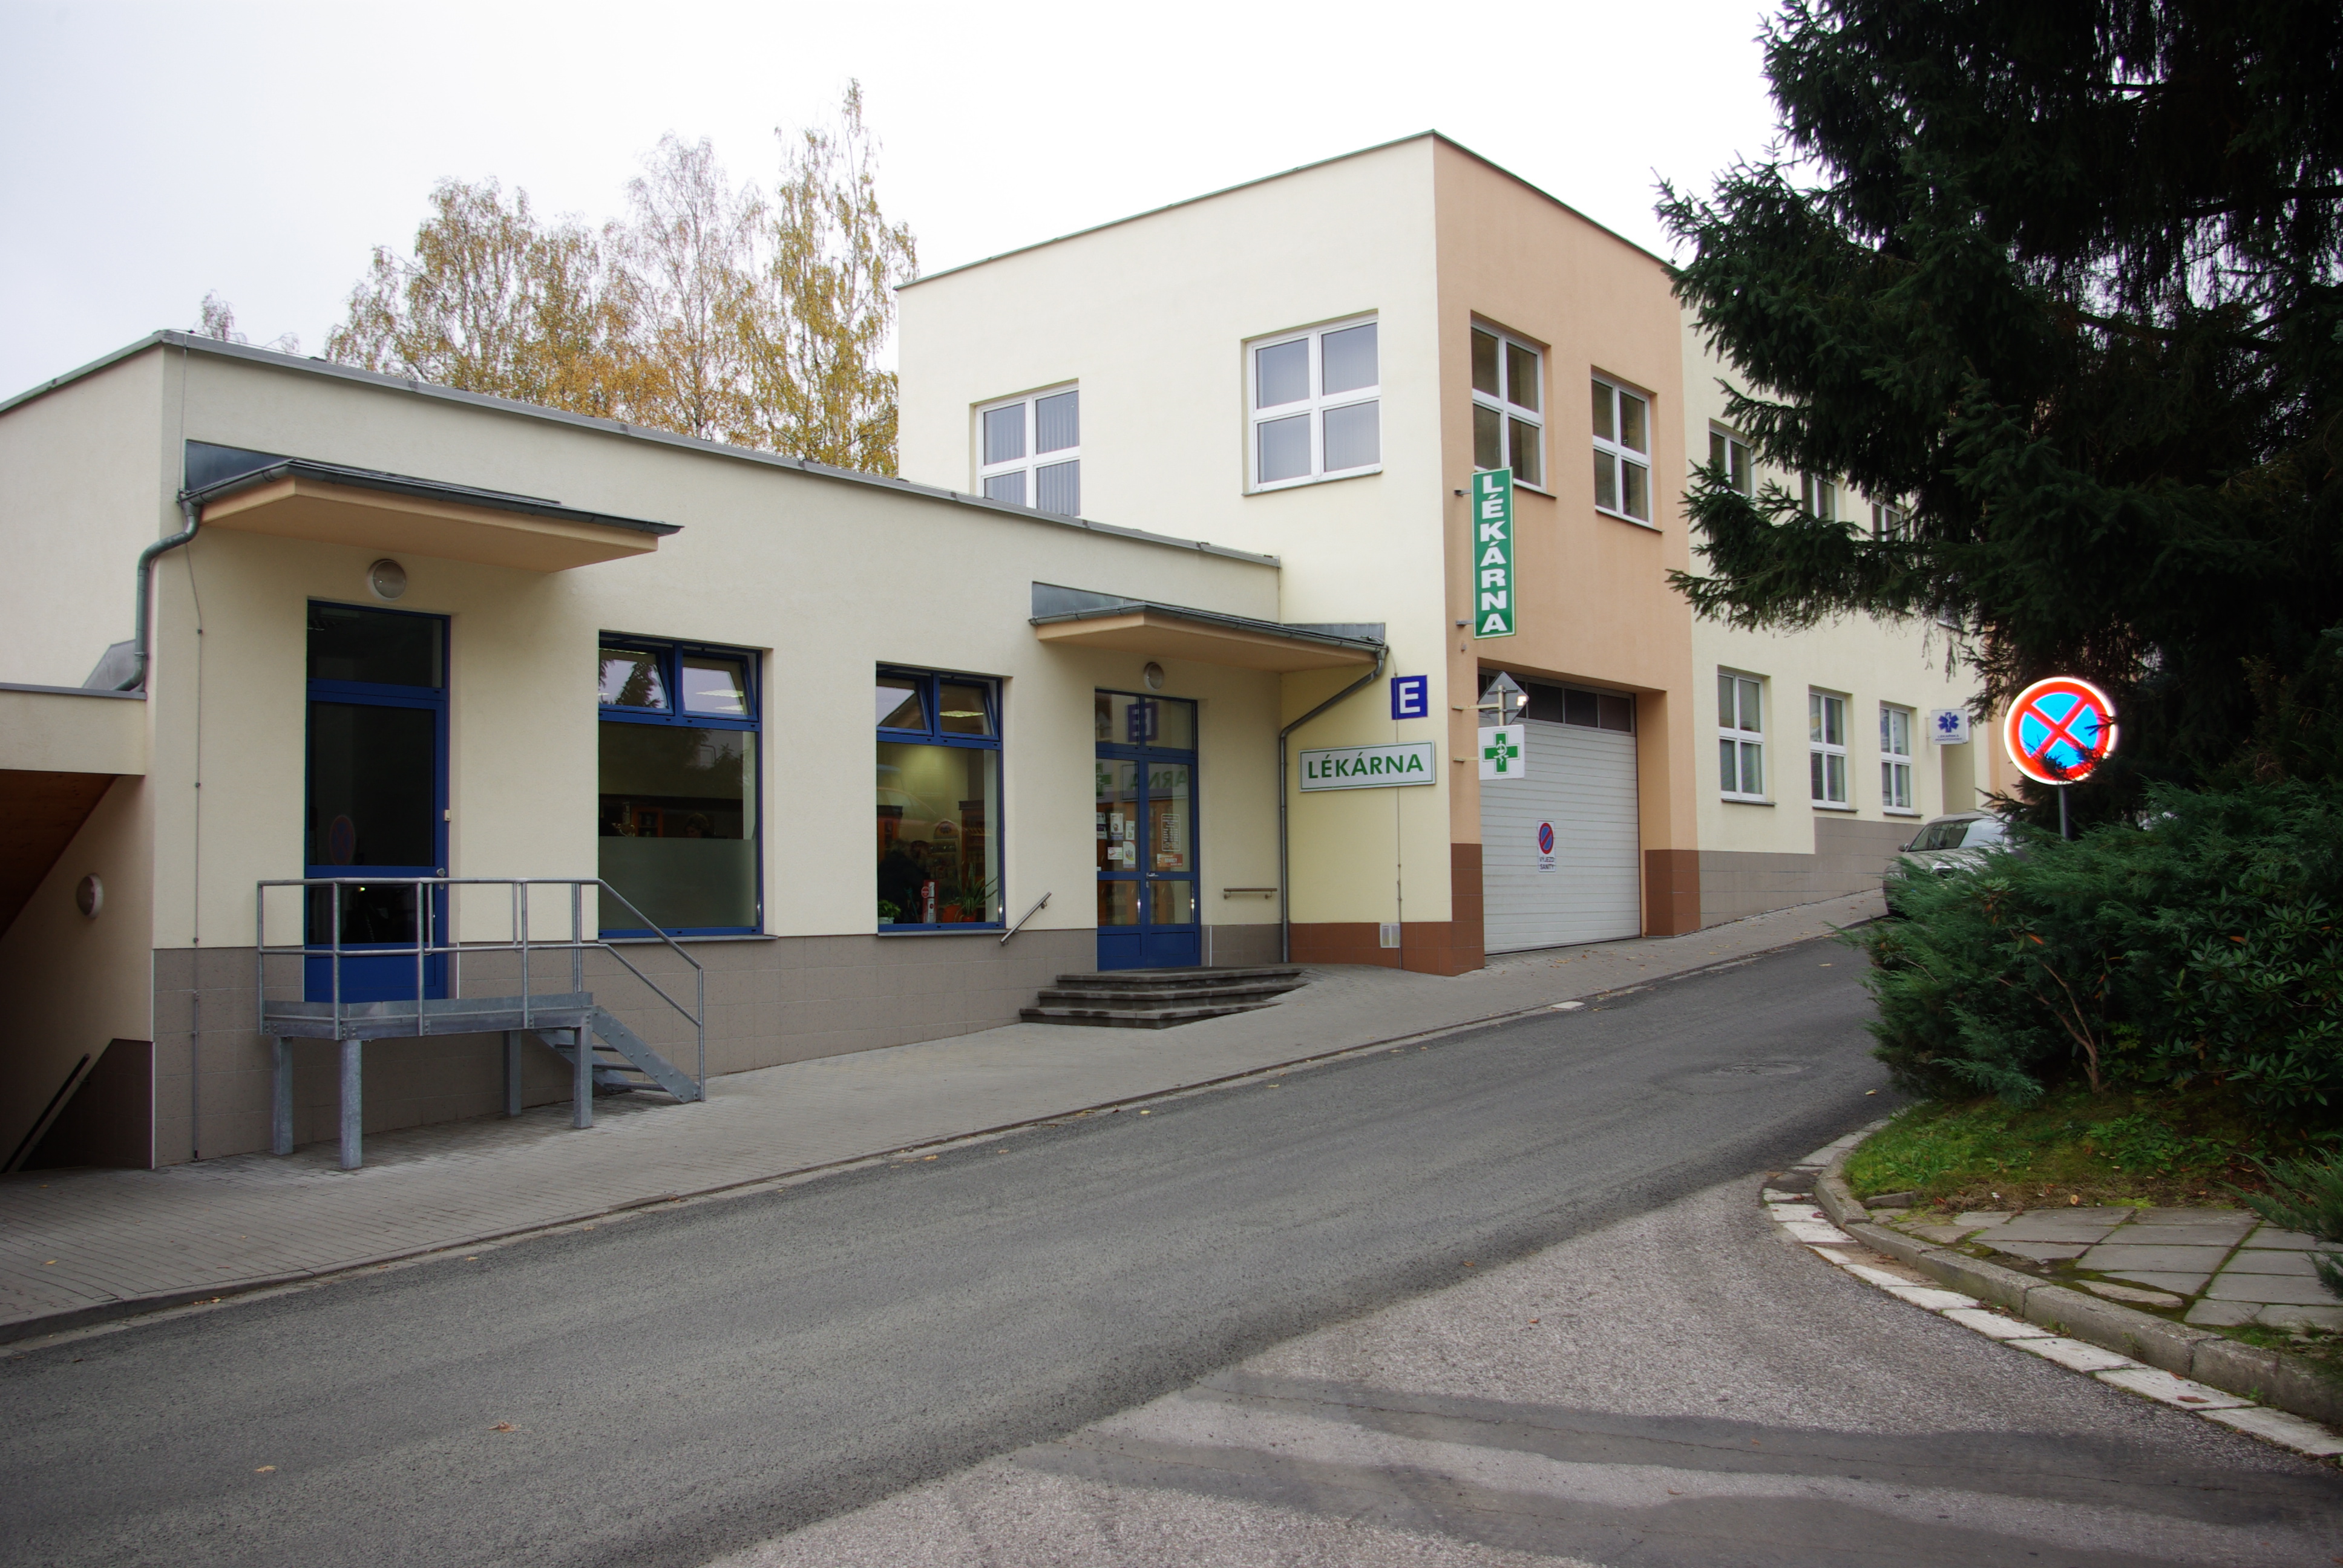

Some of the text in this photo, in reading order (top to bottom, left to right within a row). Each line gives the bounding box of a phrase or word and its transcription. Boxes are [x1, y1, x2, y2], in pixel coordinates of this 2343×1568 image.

[1480, 474, 1508, 634] LÉKÁRNA
[1398, 681, 1421, 714] E
[1308, 752, 1424, 779] LÉKÁRNA
